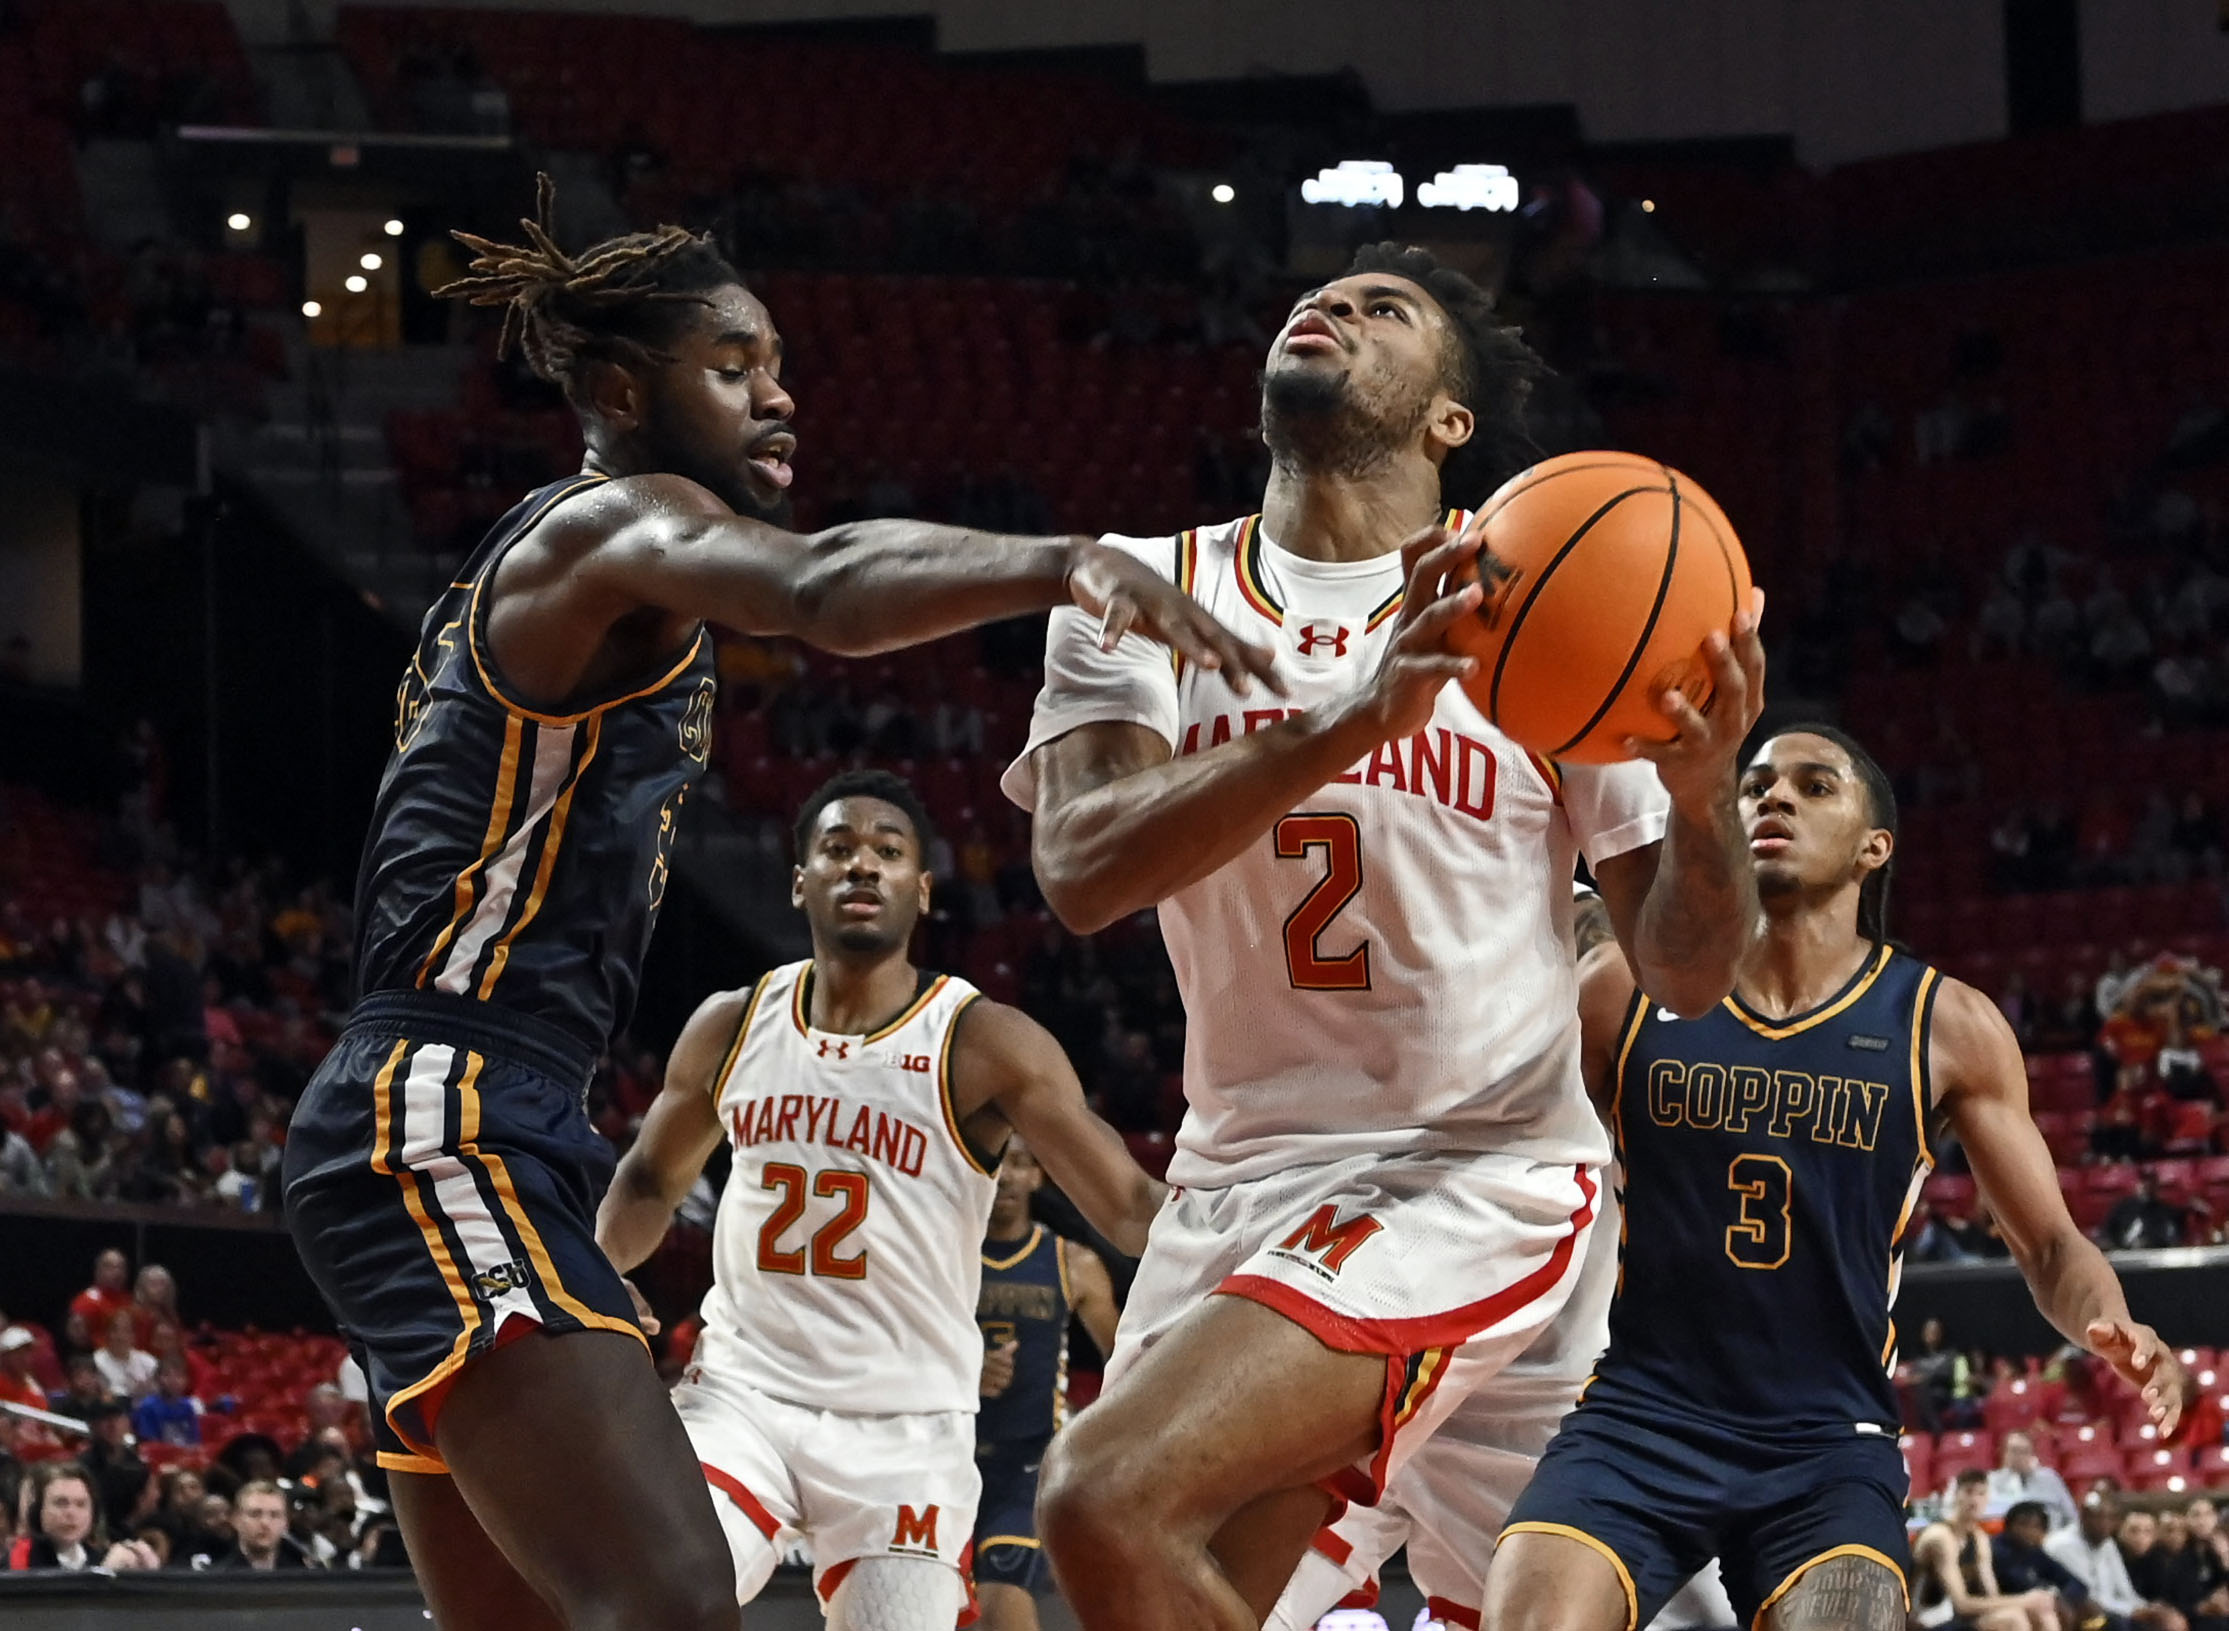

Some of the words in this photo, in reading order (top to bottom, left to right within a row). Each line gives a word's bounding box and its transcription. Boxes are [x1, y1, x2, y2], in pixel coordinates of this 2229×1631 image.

[1273, 812, 1372, 991] 2
[732, 1094, 928, 1178] MARYLAND
[1648, 1058, 1889, 1151] COPPIN
[757, 1162, 870, 1280] 22
[1275, 1203, 1385, 1276] M
[1725, 1153, 1792, 1270] 3
[890, 1503, 940, 1551] M
